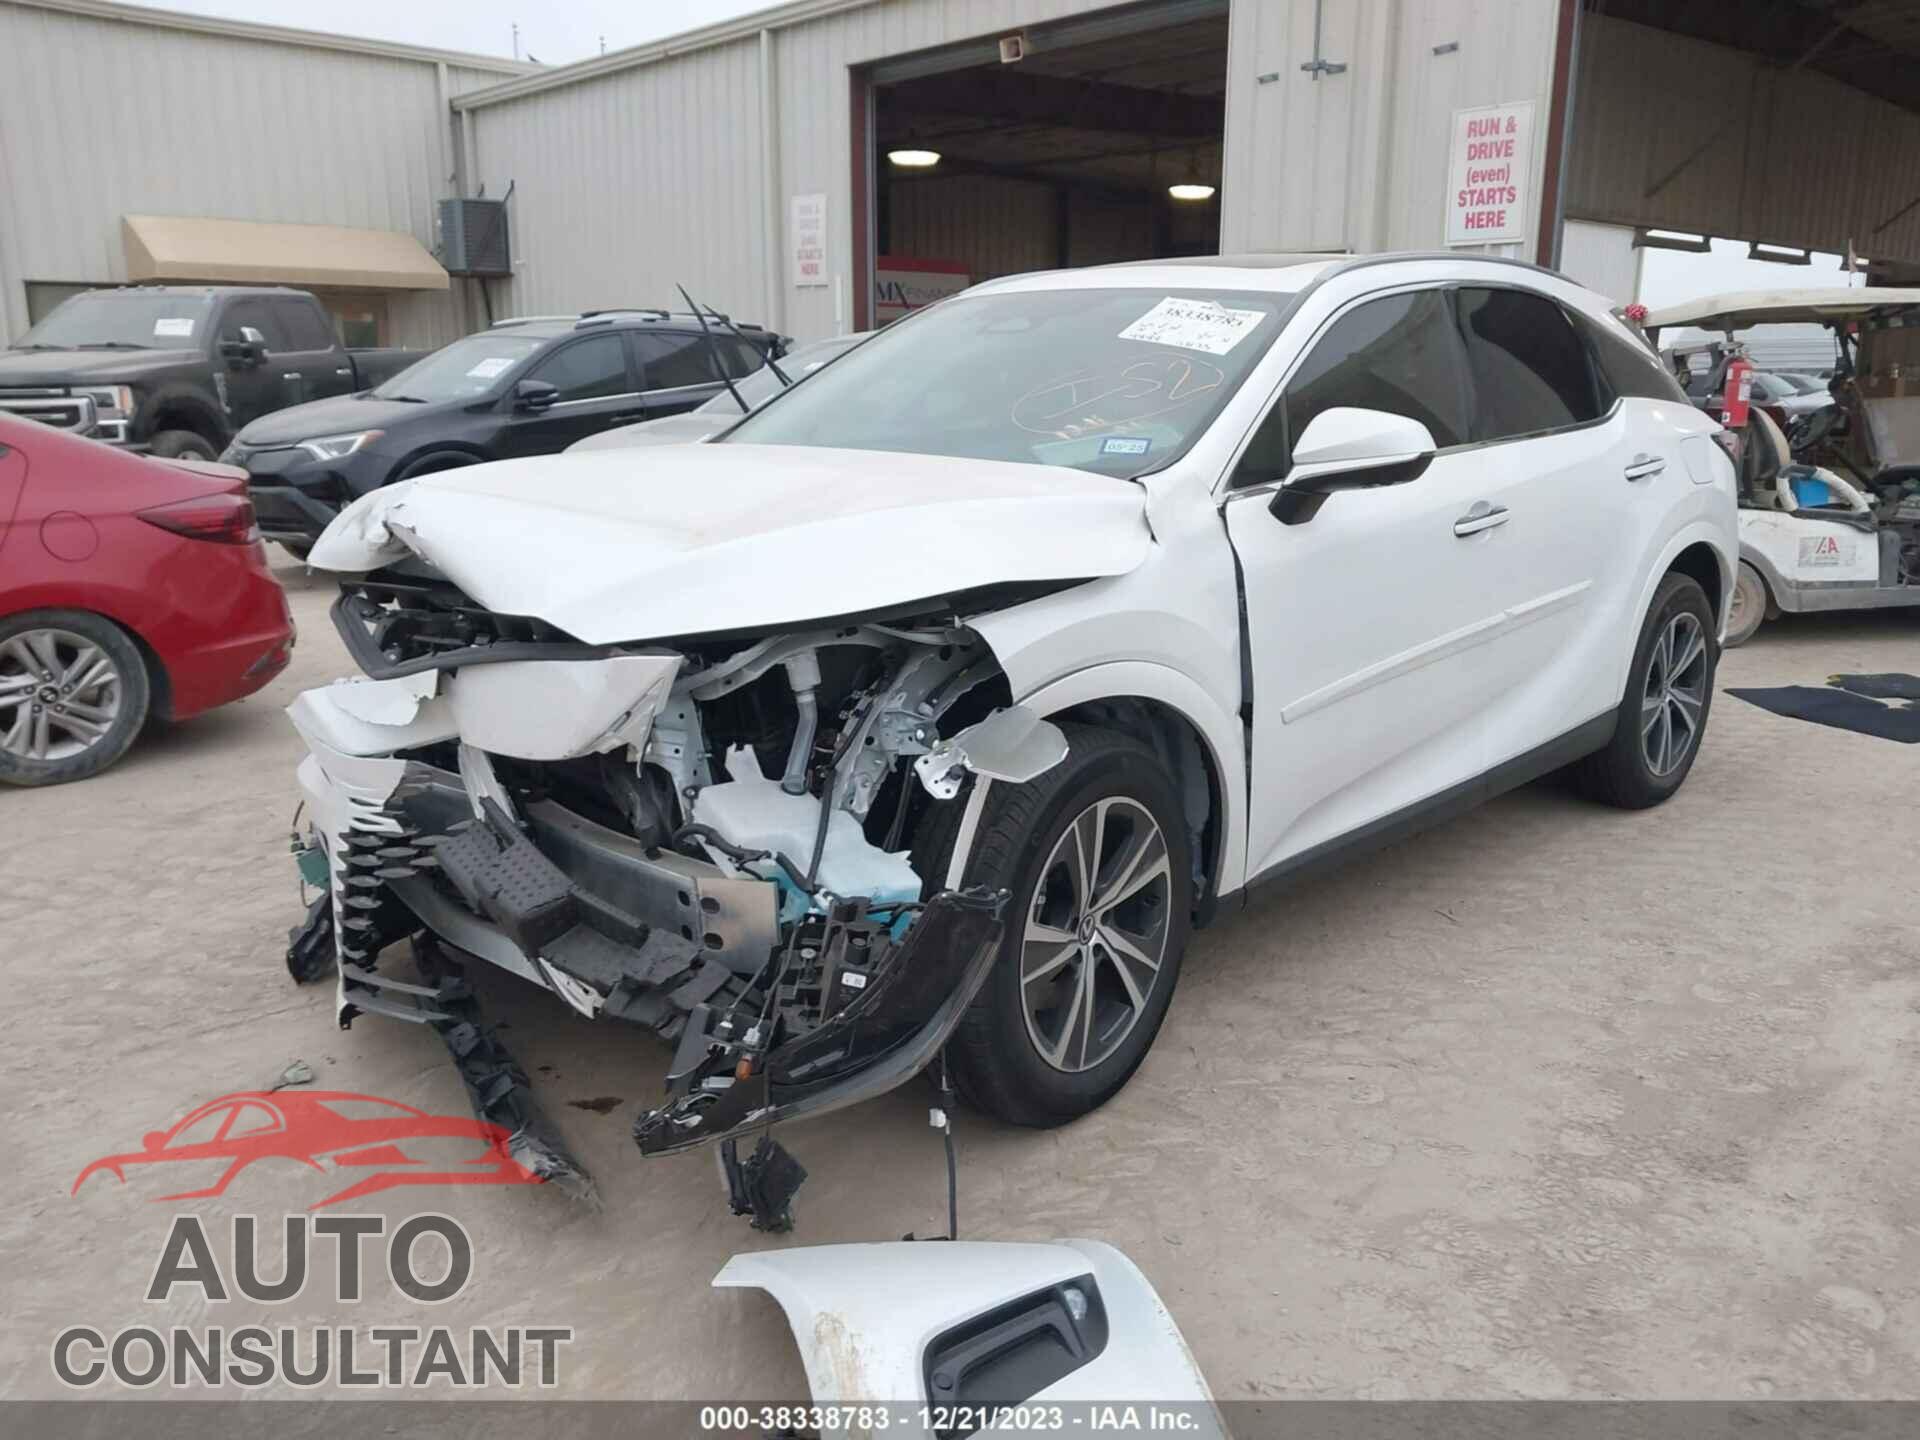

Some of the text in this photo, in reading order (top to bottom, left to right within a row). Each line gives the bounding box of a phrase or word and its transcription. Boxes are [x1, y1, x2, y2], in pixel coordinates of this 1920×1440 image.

[1467, 115, 1518, 138] RUN &
[1467, 139, 1515, 161] DRIVE
[1466, 163, 1511, 187] (even)
[1458, 186, 1516, 208] STARTS
[1465, 210, 1507, 229] HERE
